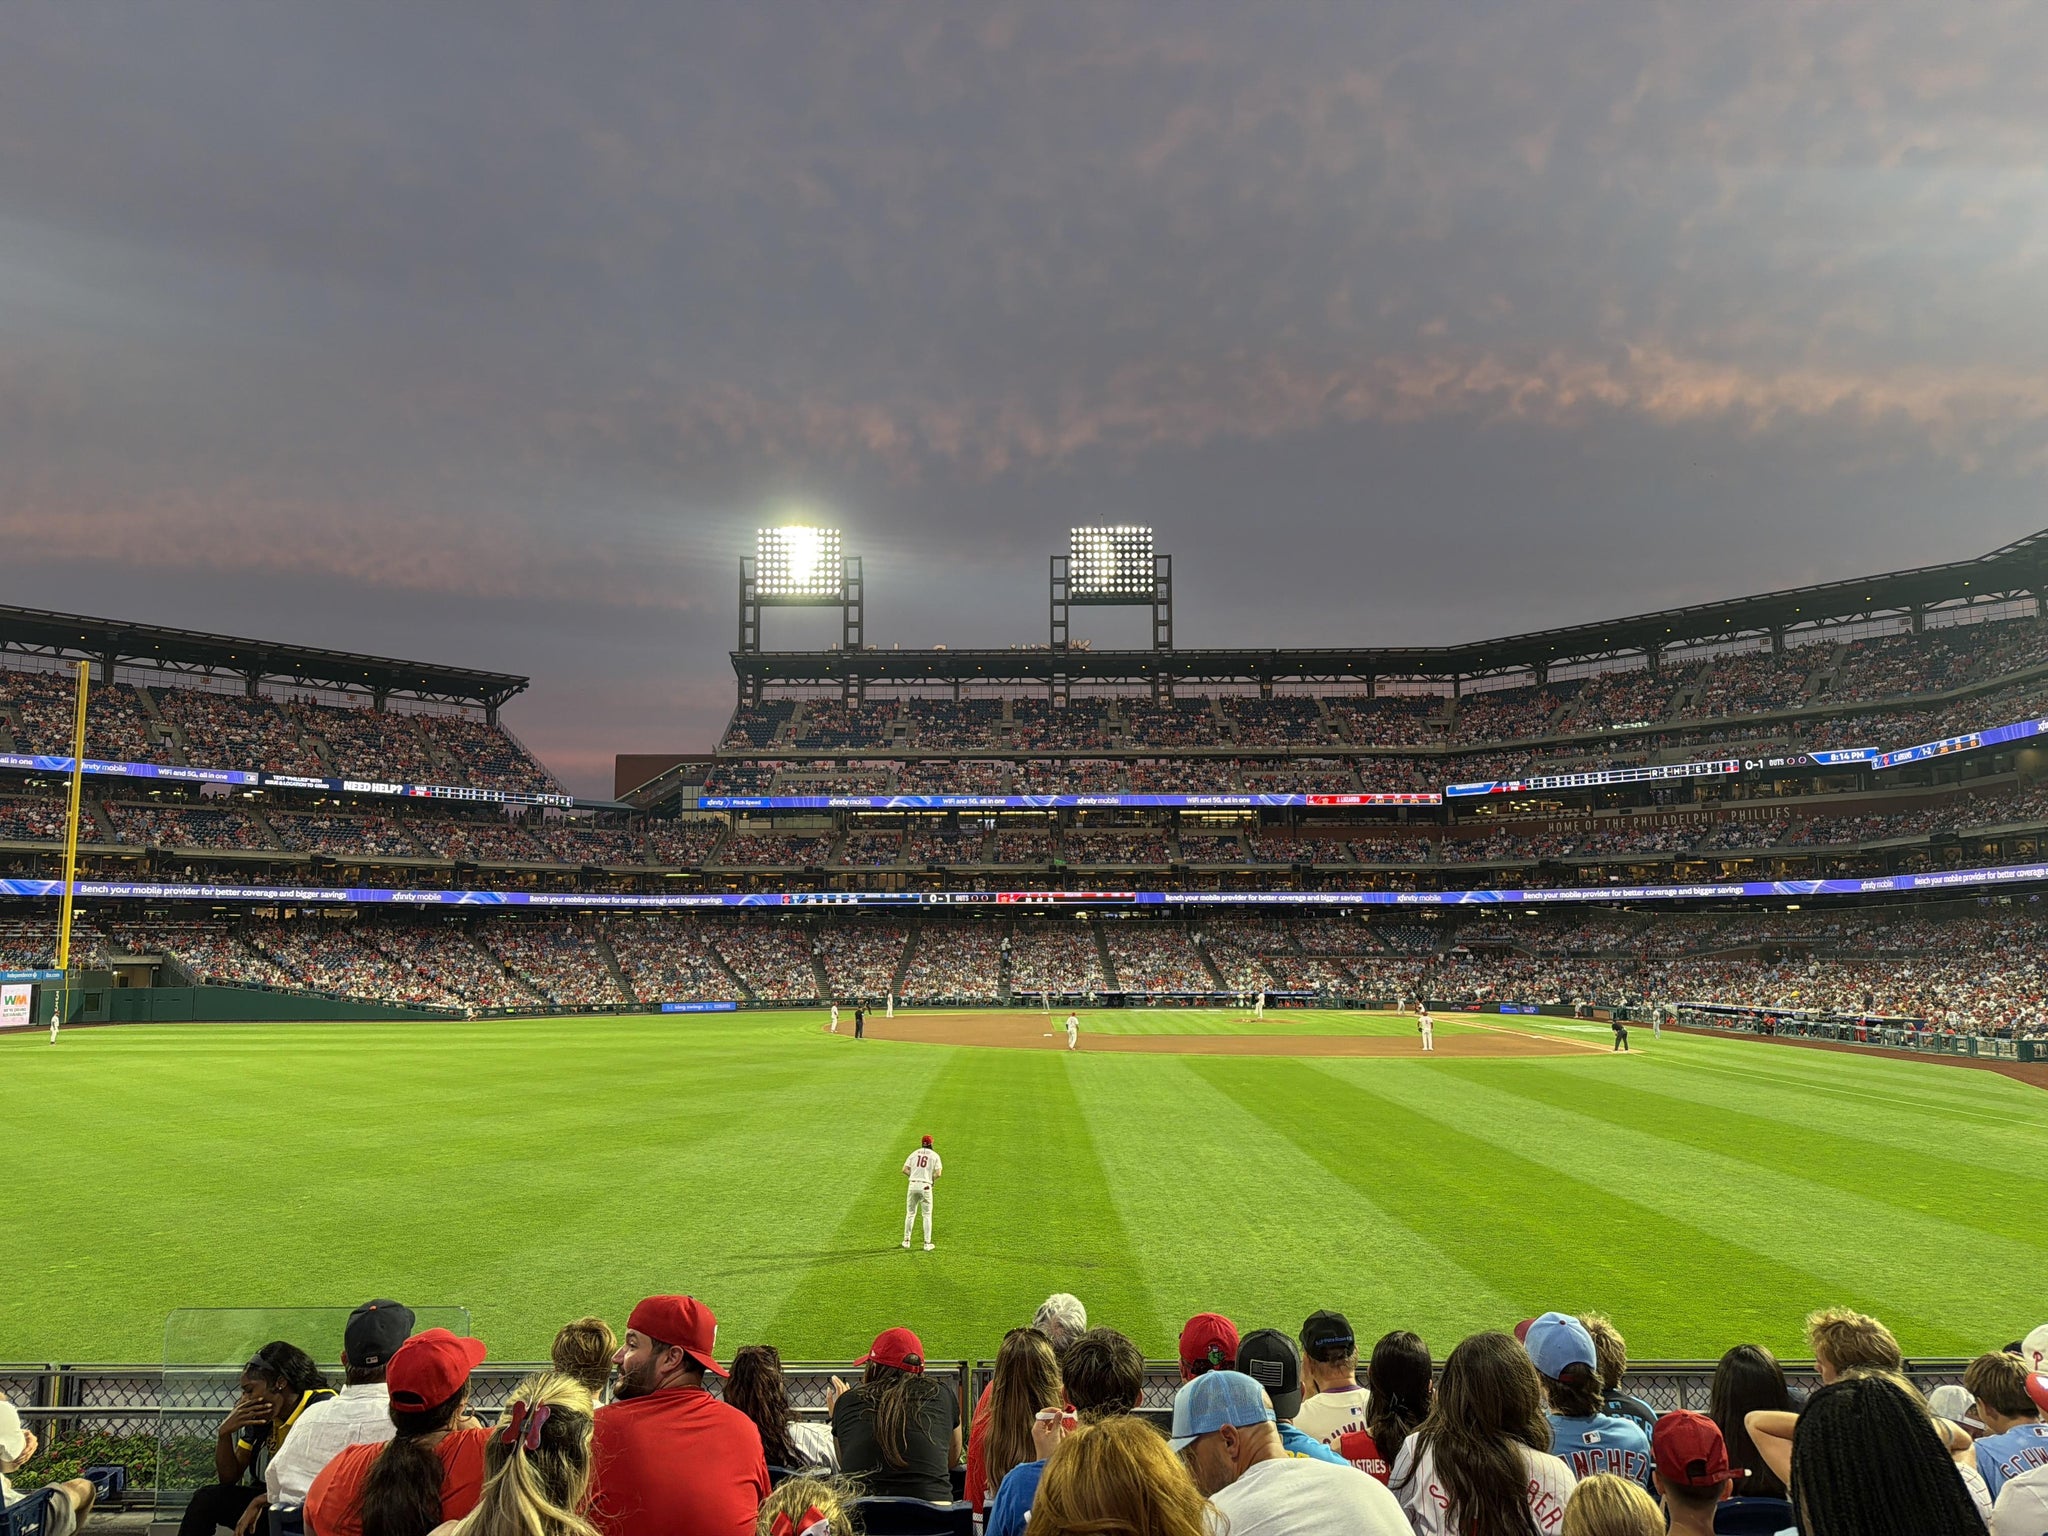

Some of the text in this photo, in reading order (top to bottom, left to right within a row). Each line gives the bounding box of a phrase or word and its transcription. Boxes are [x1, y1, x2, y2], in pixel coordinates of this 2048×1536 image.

[1831, 751, 1864, 761] 8:14 PM
[1768, 758, 1784, 766] OUTS
[102, 764, 127, 772] mobile
[344, 780, 370, 792] NEED
[372, 782, 404, 794] HELP?
[828, 798, 850, 808] xfinity
[1076, 796, 1098, 806] xfinity
[1548, 819, 1580, 833] HOME
[1586, 819, 1599, 830] OF
[1606, 816, 1627, 829] THE
[1634, 810, 1722, 829] PHILADELPHI
[1914, 868, 2045, 886] Bench your mobile provider for better coverage
[1860, 880, 1894, 892] xfinity mobile
[81, 885, 347, 900] Bench your mobile provider for better coverage and bigger savings
[392, 892, 442, 901] xfinity mobile
[1222, 894, 1247, 902] provider
[1320, 894, 1340, 902] bigger
[1582, 891, 1610, 900] provider
[1622, 889, 1644, 897] better
[1646, 889, 1678, 898] coverage
[1694, 887, 1716, 896] bigger
[1718, 886, 1744, 895] savings
[550, 897, 563, 905] your
[586, 896, 611, 905] provider
[681, 897, 700, 906] bigger
[1397, 894, 1418, 903] xfinity
[4, 994, 27, 1006] WM
[916, 1154, 929, 1168] 16
[2033, 1351, 2044, 1370] P
